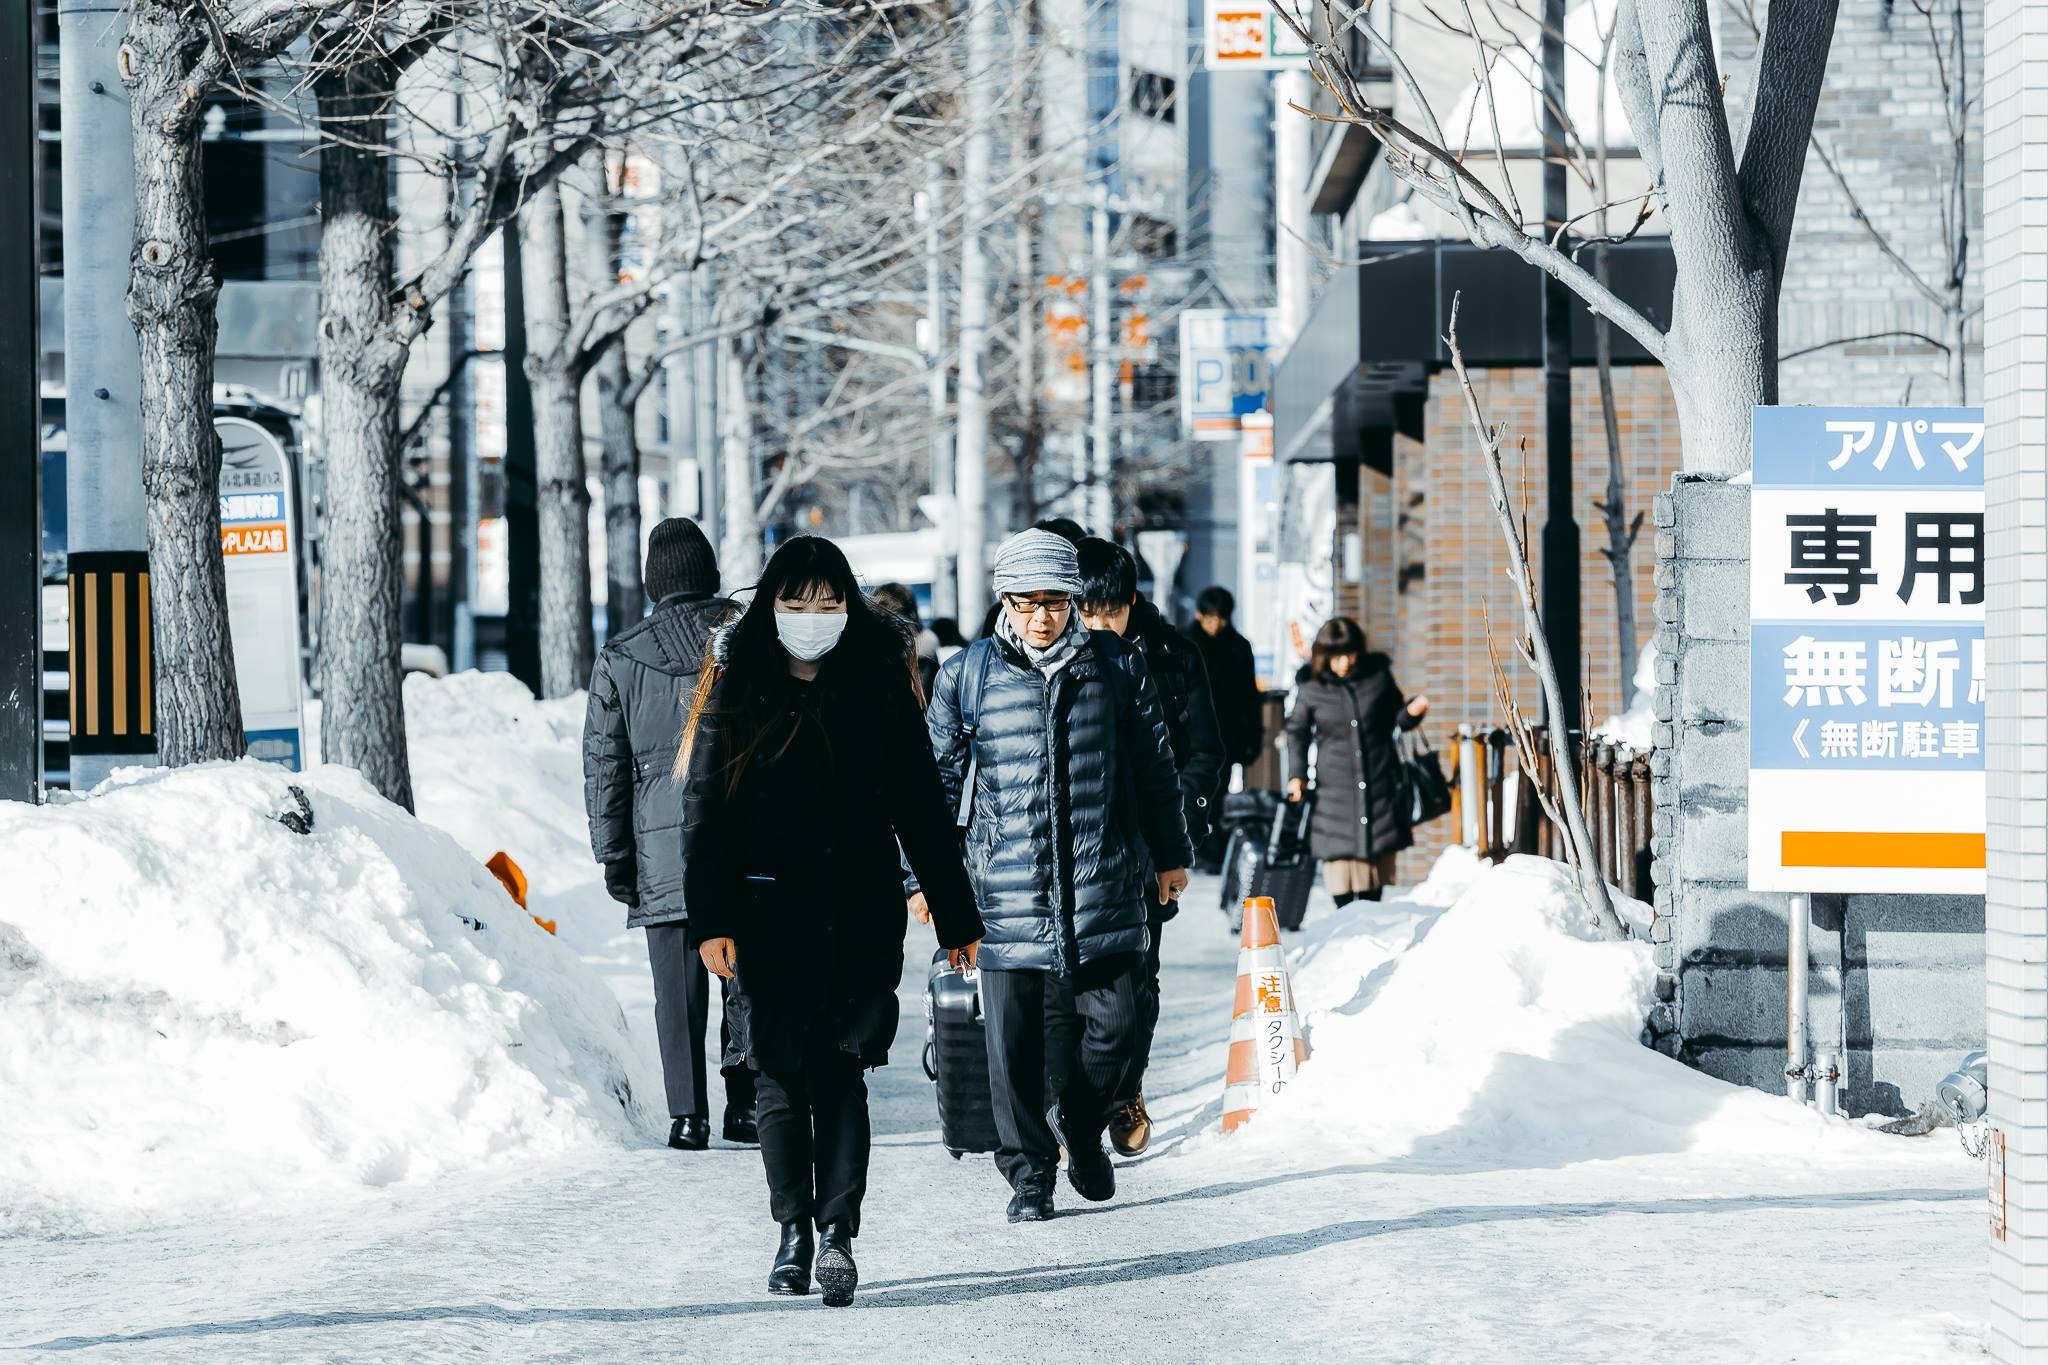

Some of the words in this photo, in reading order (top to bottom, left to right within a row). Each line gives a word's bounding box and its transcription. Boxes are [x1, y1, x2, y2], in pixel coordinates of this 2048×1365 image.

[1825, 419, 1985, 472] アパマ
[1784, 508, 1985, 606] 専用
[1782, 635, 1985, 709] 無断
[1259, 975, 1283, 1014] 注意
[1267, 1020, 1287, 1094] タクシーの
